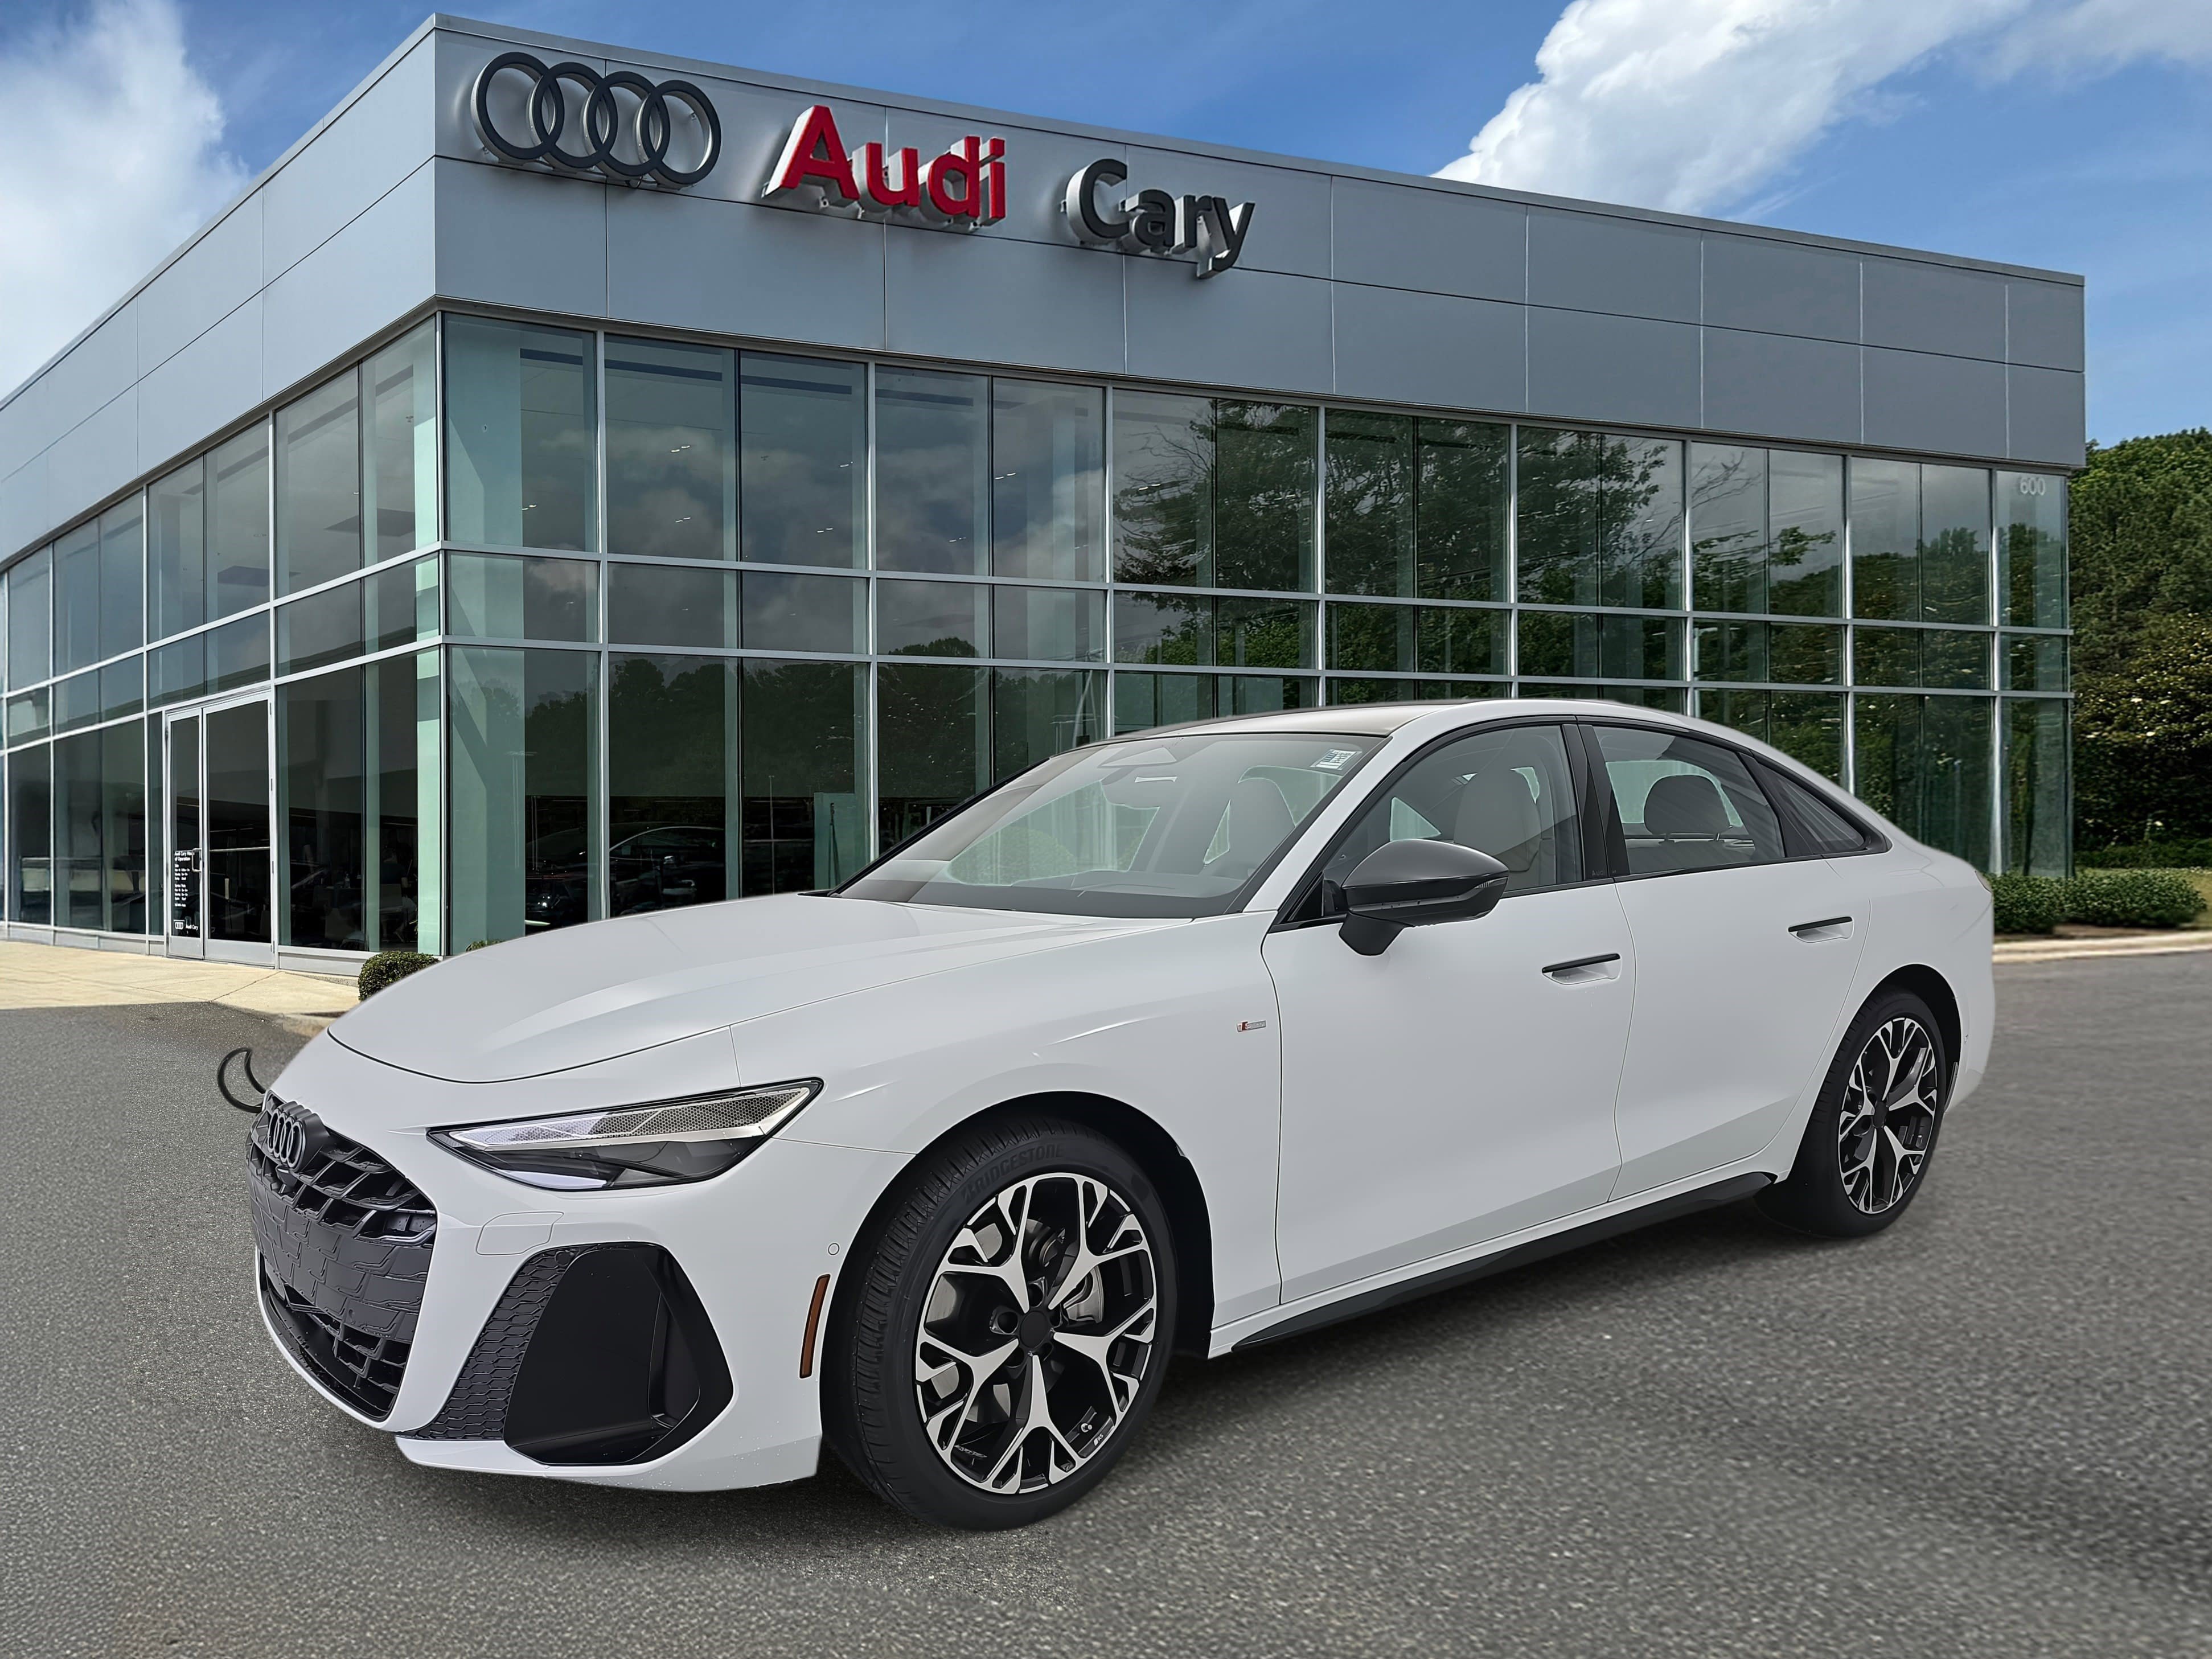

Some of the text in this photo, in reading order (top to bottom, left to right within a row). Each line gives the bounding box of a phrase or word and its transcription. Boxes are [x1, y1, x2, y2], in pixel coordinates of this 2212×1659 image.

[766, 105, 1255, 278] Audi Cary
[2020, 477, 2046, 495] 600
[961, 1143, 1063, 1205] BRIDGESTONE
